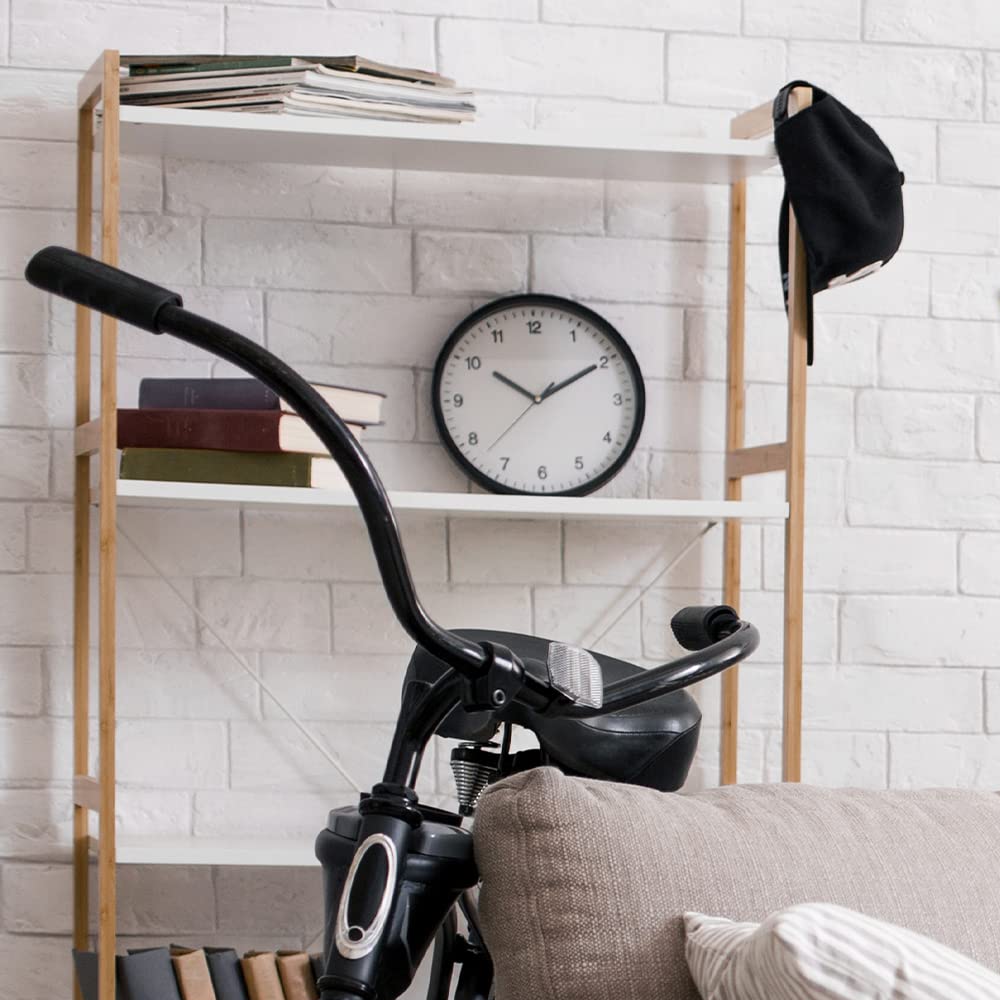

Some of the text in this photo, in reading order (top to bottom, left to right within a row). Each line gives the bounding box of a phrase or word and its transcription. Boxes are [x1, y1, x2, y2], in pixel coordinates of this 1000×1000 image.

[527, 321, 542, 334] 12
[491, 330, 504, 343] 11
[570, 330, 576, 342] 1
[465, 356, 481, 370] 10
[599, 357, 609, 369] 2
[453, 394, 464, 408] 9
[613, 394, 623, 406] 3
[468, 432, 478, 445] 8
[603, 432, 612, 443] 4
[500, 457, 510, 471] 7
[575, 456, 584, 470] 5
[537, 466, 548, 479] 6
